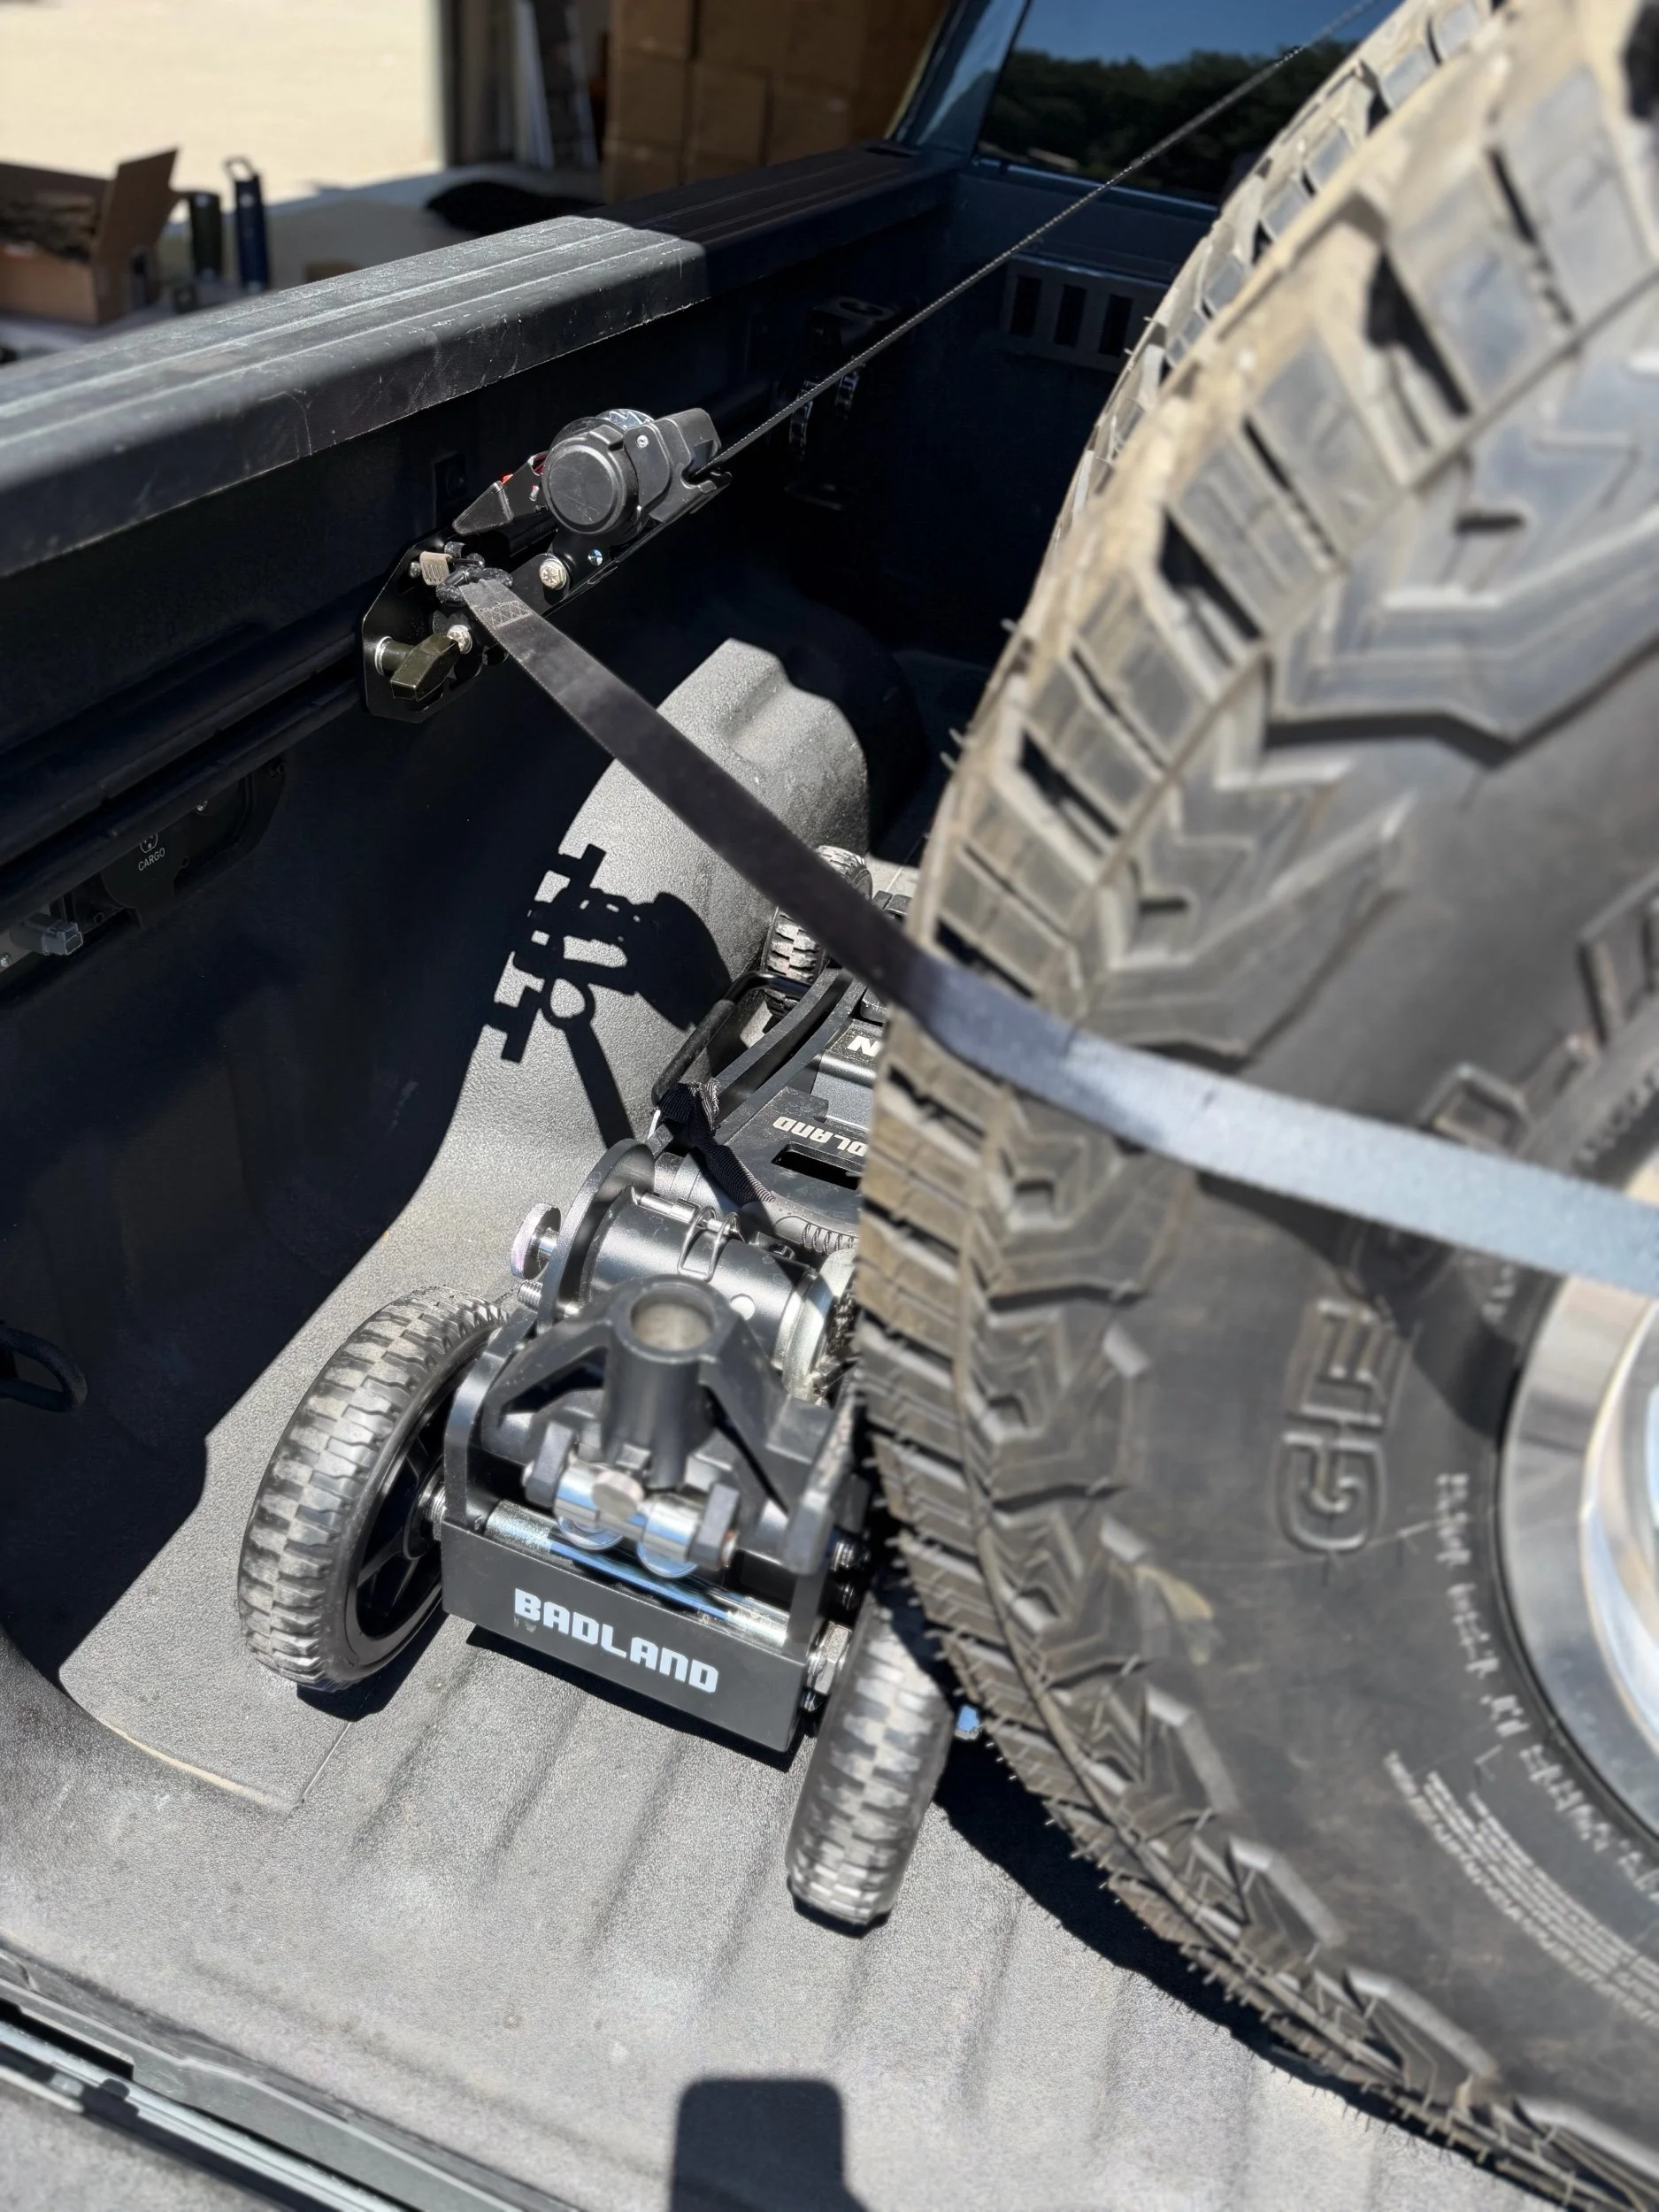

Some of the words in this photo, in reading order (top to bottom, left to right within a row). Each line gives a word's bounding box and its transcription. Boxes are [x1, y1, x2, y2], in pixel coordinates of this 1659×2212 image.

[138, 847, 166, 872] CARGO
[772, 1116, 869, 1157] DLAND
[514, 1587, 719, 1694] BADLAND
